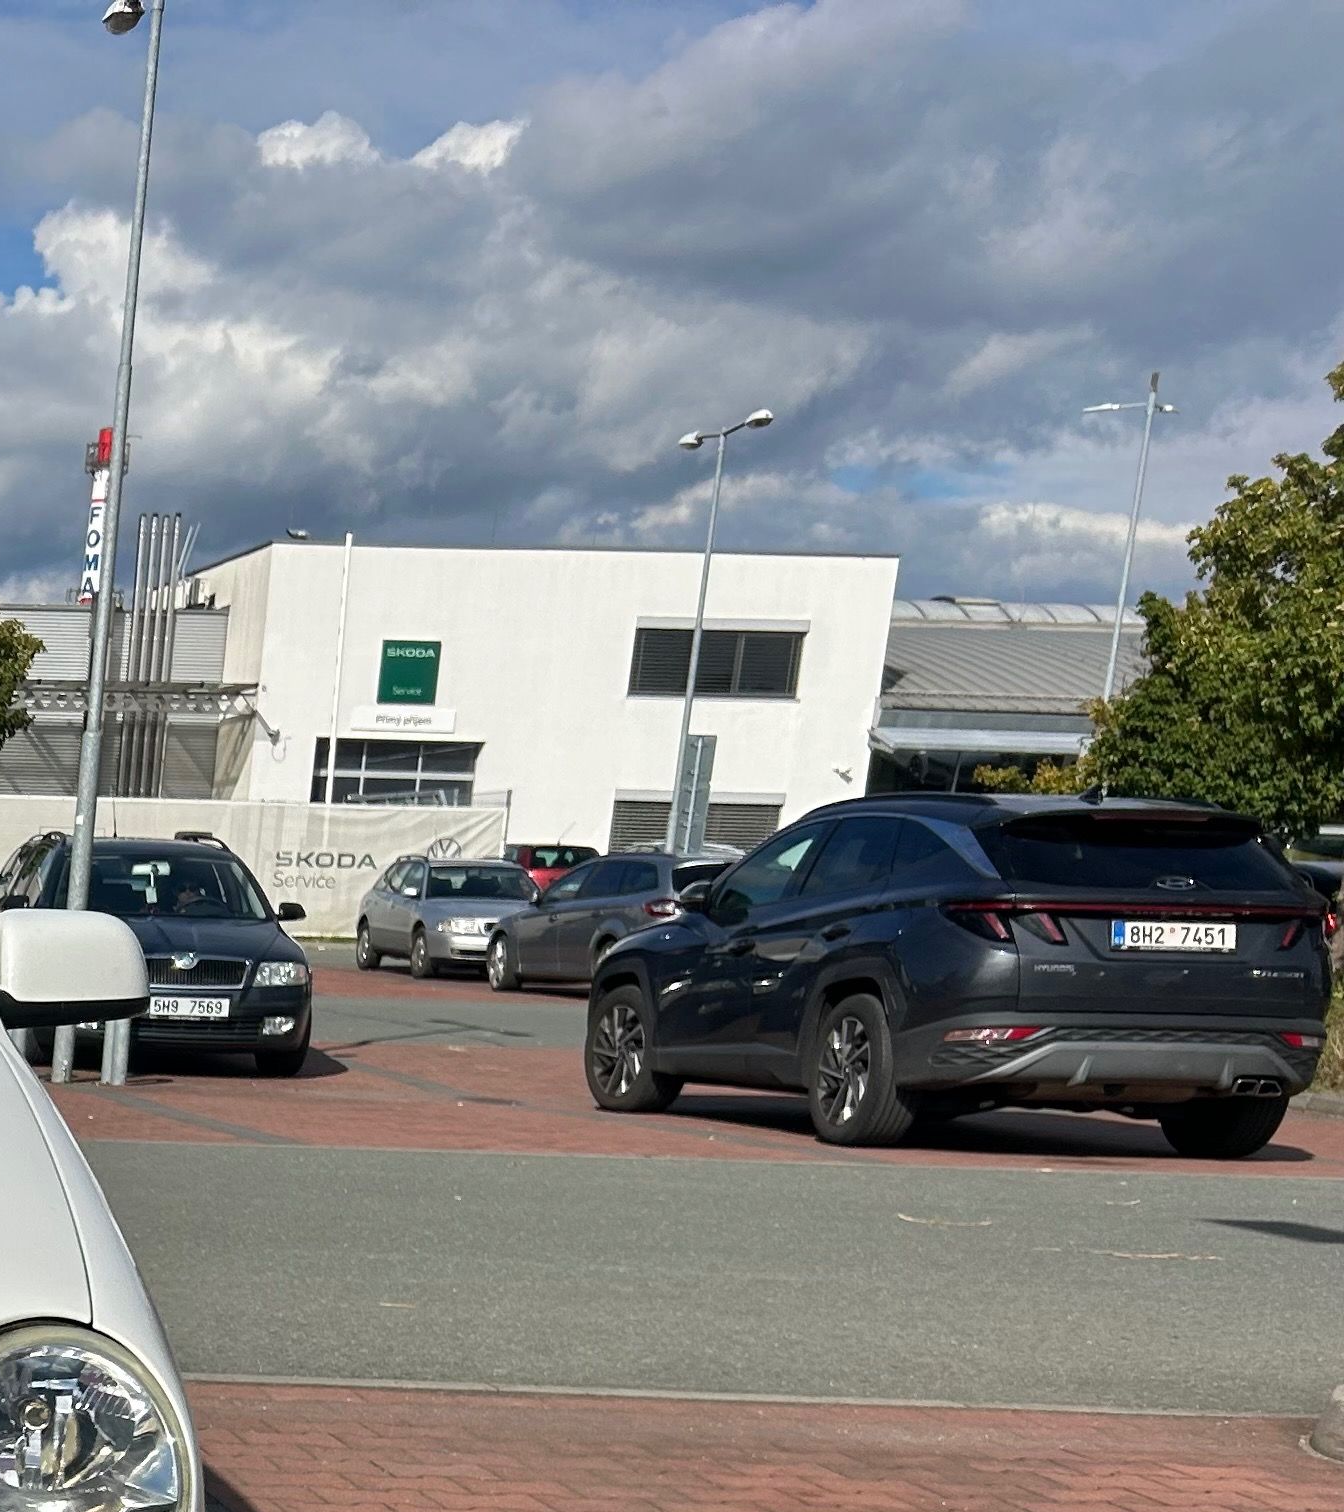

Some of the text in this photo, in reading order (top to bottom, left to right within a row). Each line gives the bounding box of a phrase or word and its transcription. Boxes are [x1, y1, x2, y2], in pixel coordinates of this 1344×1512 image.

[82, 507, 102, 595] FOMA
[273, 871, 336, 889] Service
[1130, 925, 1165, 944] 8H2
[1180, 927, 1226, 946] 7451
[154, 999, 223, 1014] 5H9 7569
